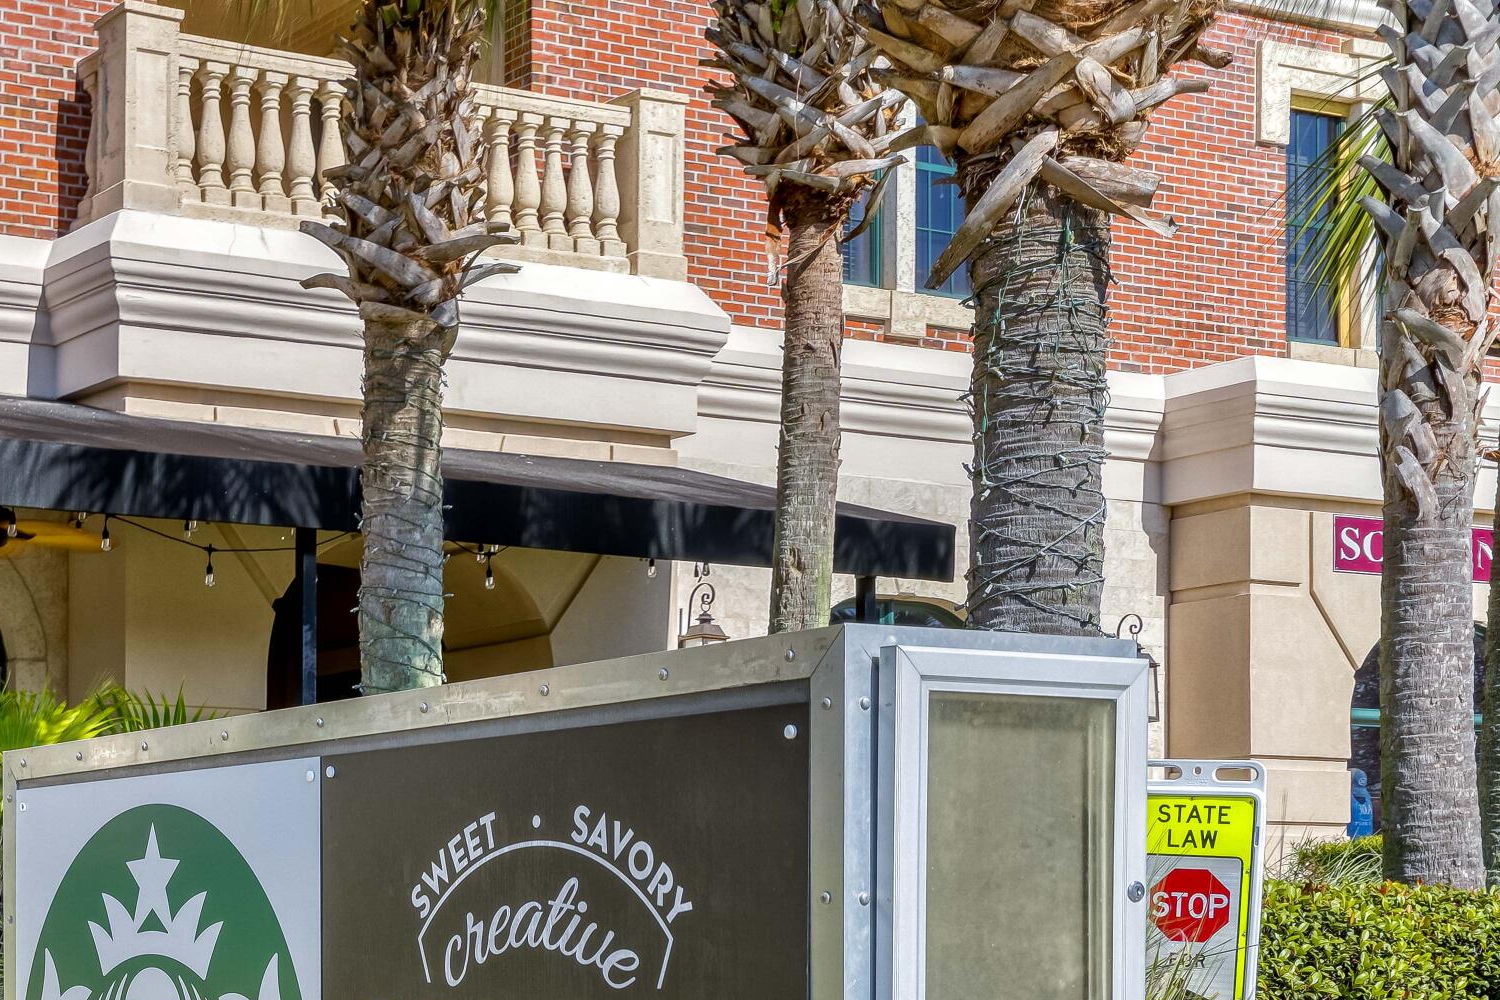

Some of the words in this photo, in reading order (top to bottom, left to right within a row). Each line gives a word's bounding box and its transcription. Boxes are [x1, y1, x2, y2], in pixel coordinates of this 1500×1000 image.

[1157, 804, 1231, 825] STATE
[1167, 829, 1218, 849] LAW
[411, 812, 496, 918] SWEET
[570, 805, 693, 923] SAVORY
[1152, 891, 1229, 919] STOP
[444, 877, 640, 989] creative
